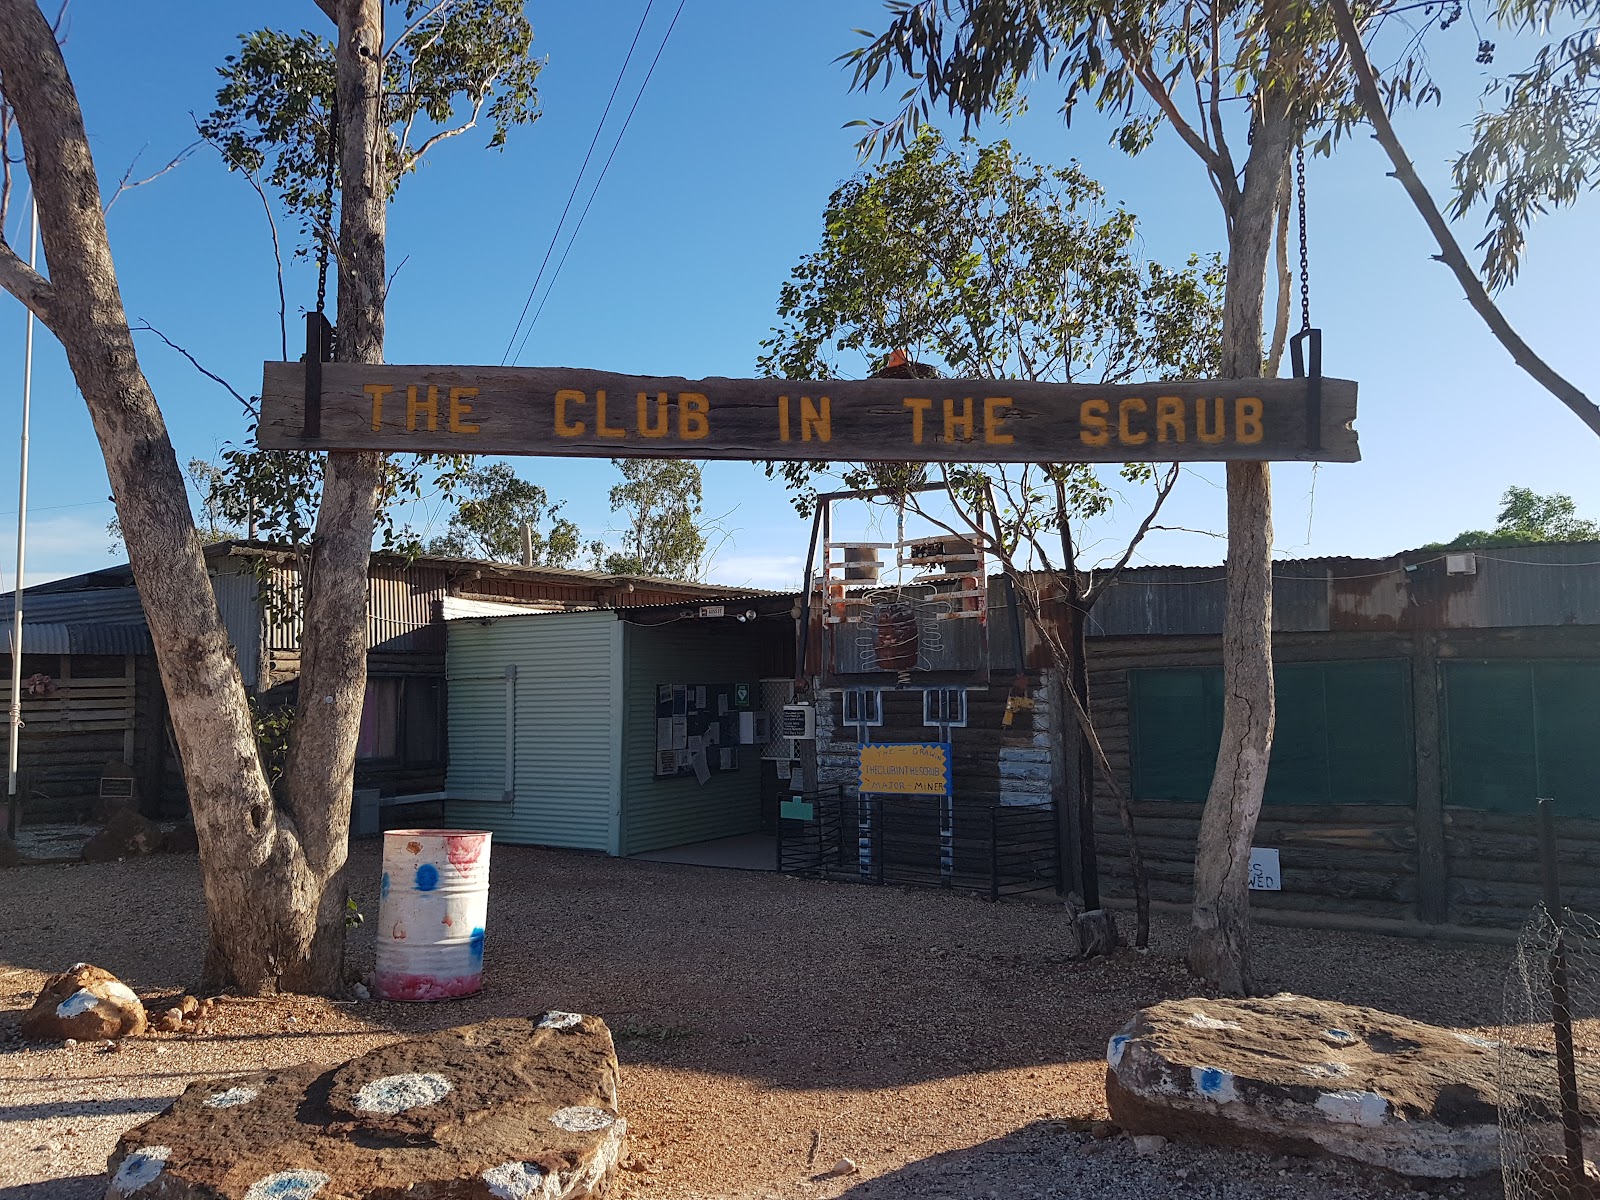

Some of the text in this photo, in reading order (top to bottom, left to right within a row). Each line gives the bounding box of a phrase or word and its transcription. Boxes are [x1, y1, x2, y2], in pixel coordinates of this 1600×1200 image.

[363, 384, 1265, 447] THE CLUB IN THE SCRUB
[877, 749, 894, 757] THE
[871, 781, 905, 790] MAJOR
